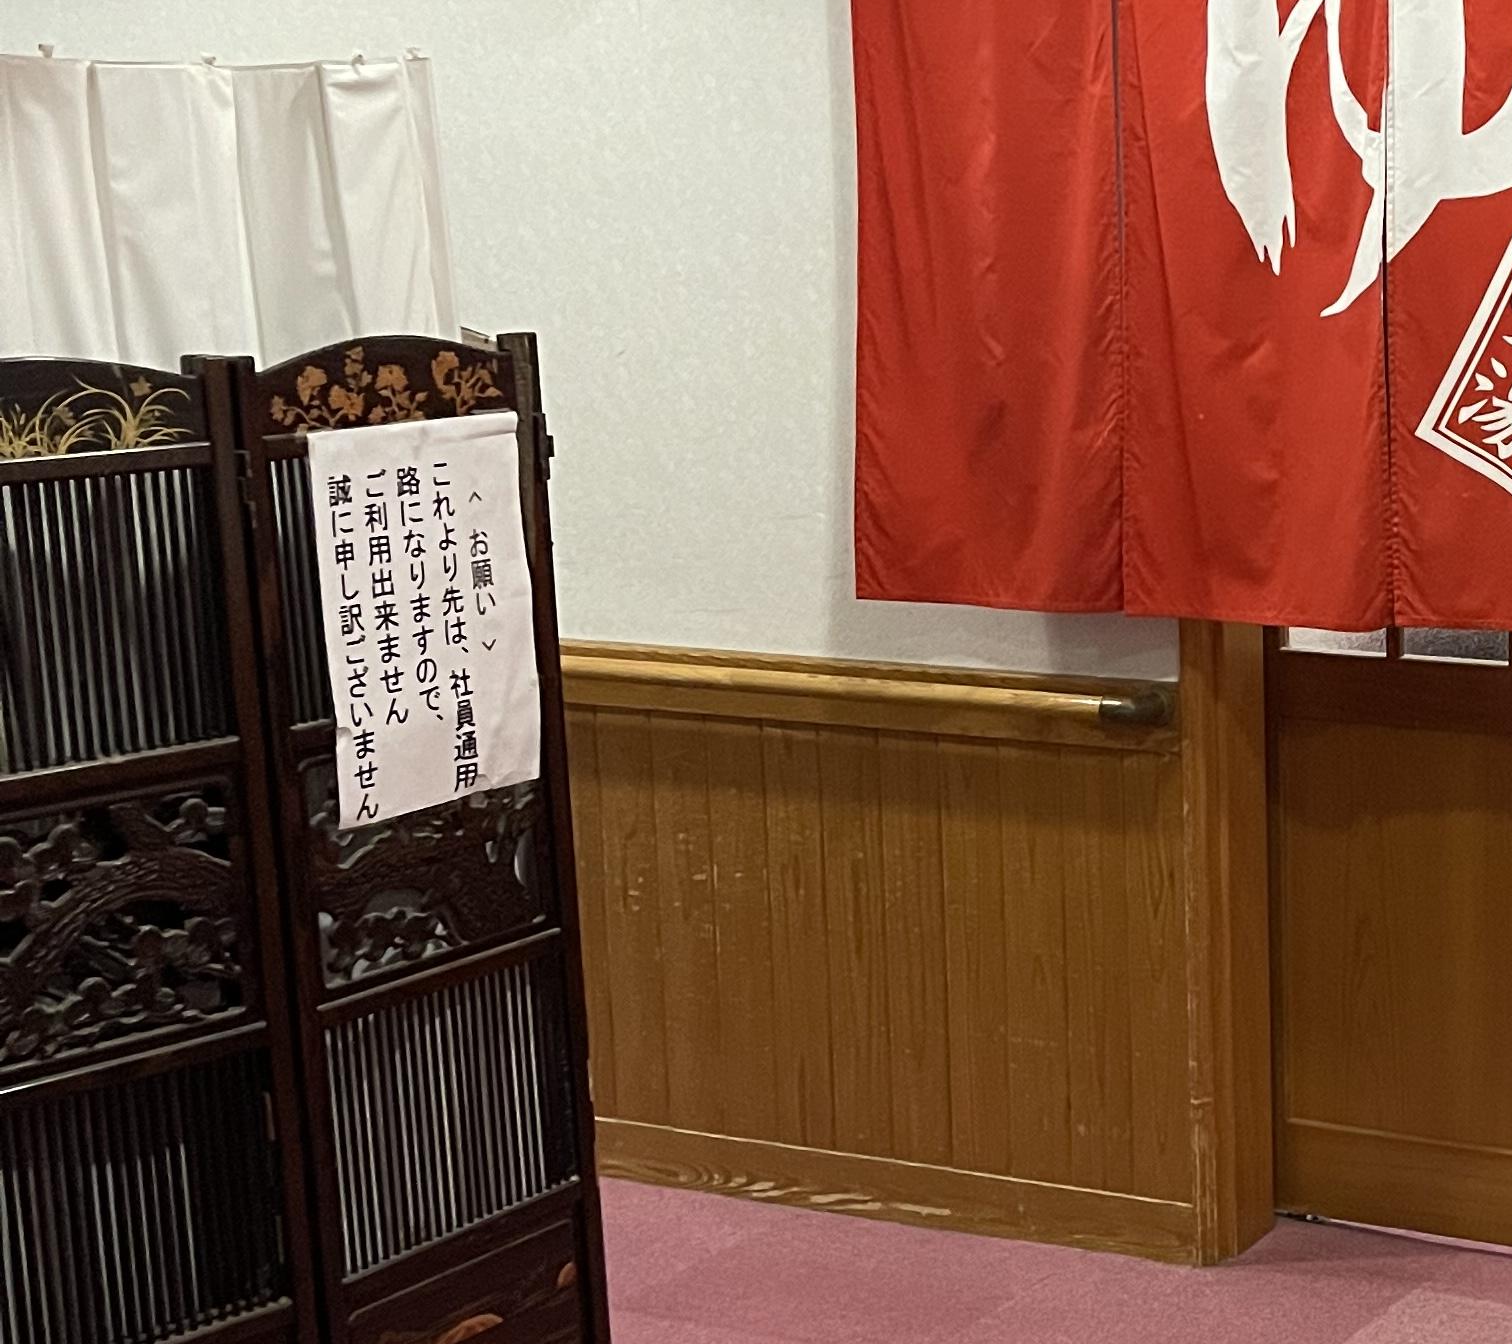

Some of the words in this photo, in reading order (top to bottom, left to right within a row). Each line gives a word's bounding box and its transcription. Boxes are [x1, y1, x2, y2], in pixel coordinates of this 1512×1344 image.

[326, 473, 380, 822] 誠に申し訳ございません
[362, 467, 410, 727] ご利用出来ません
[394, 466, 446, 722] 路になりますので、
[430, 460, 480, 794] これより先は、社員通用
[468, 528, 496, 617] お願い
